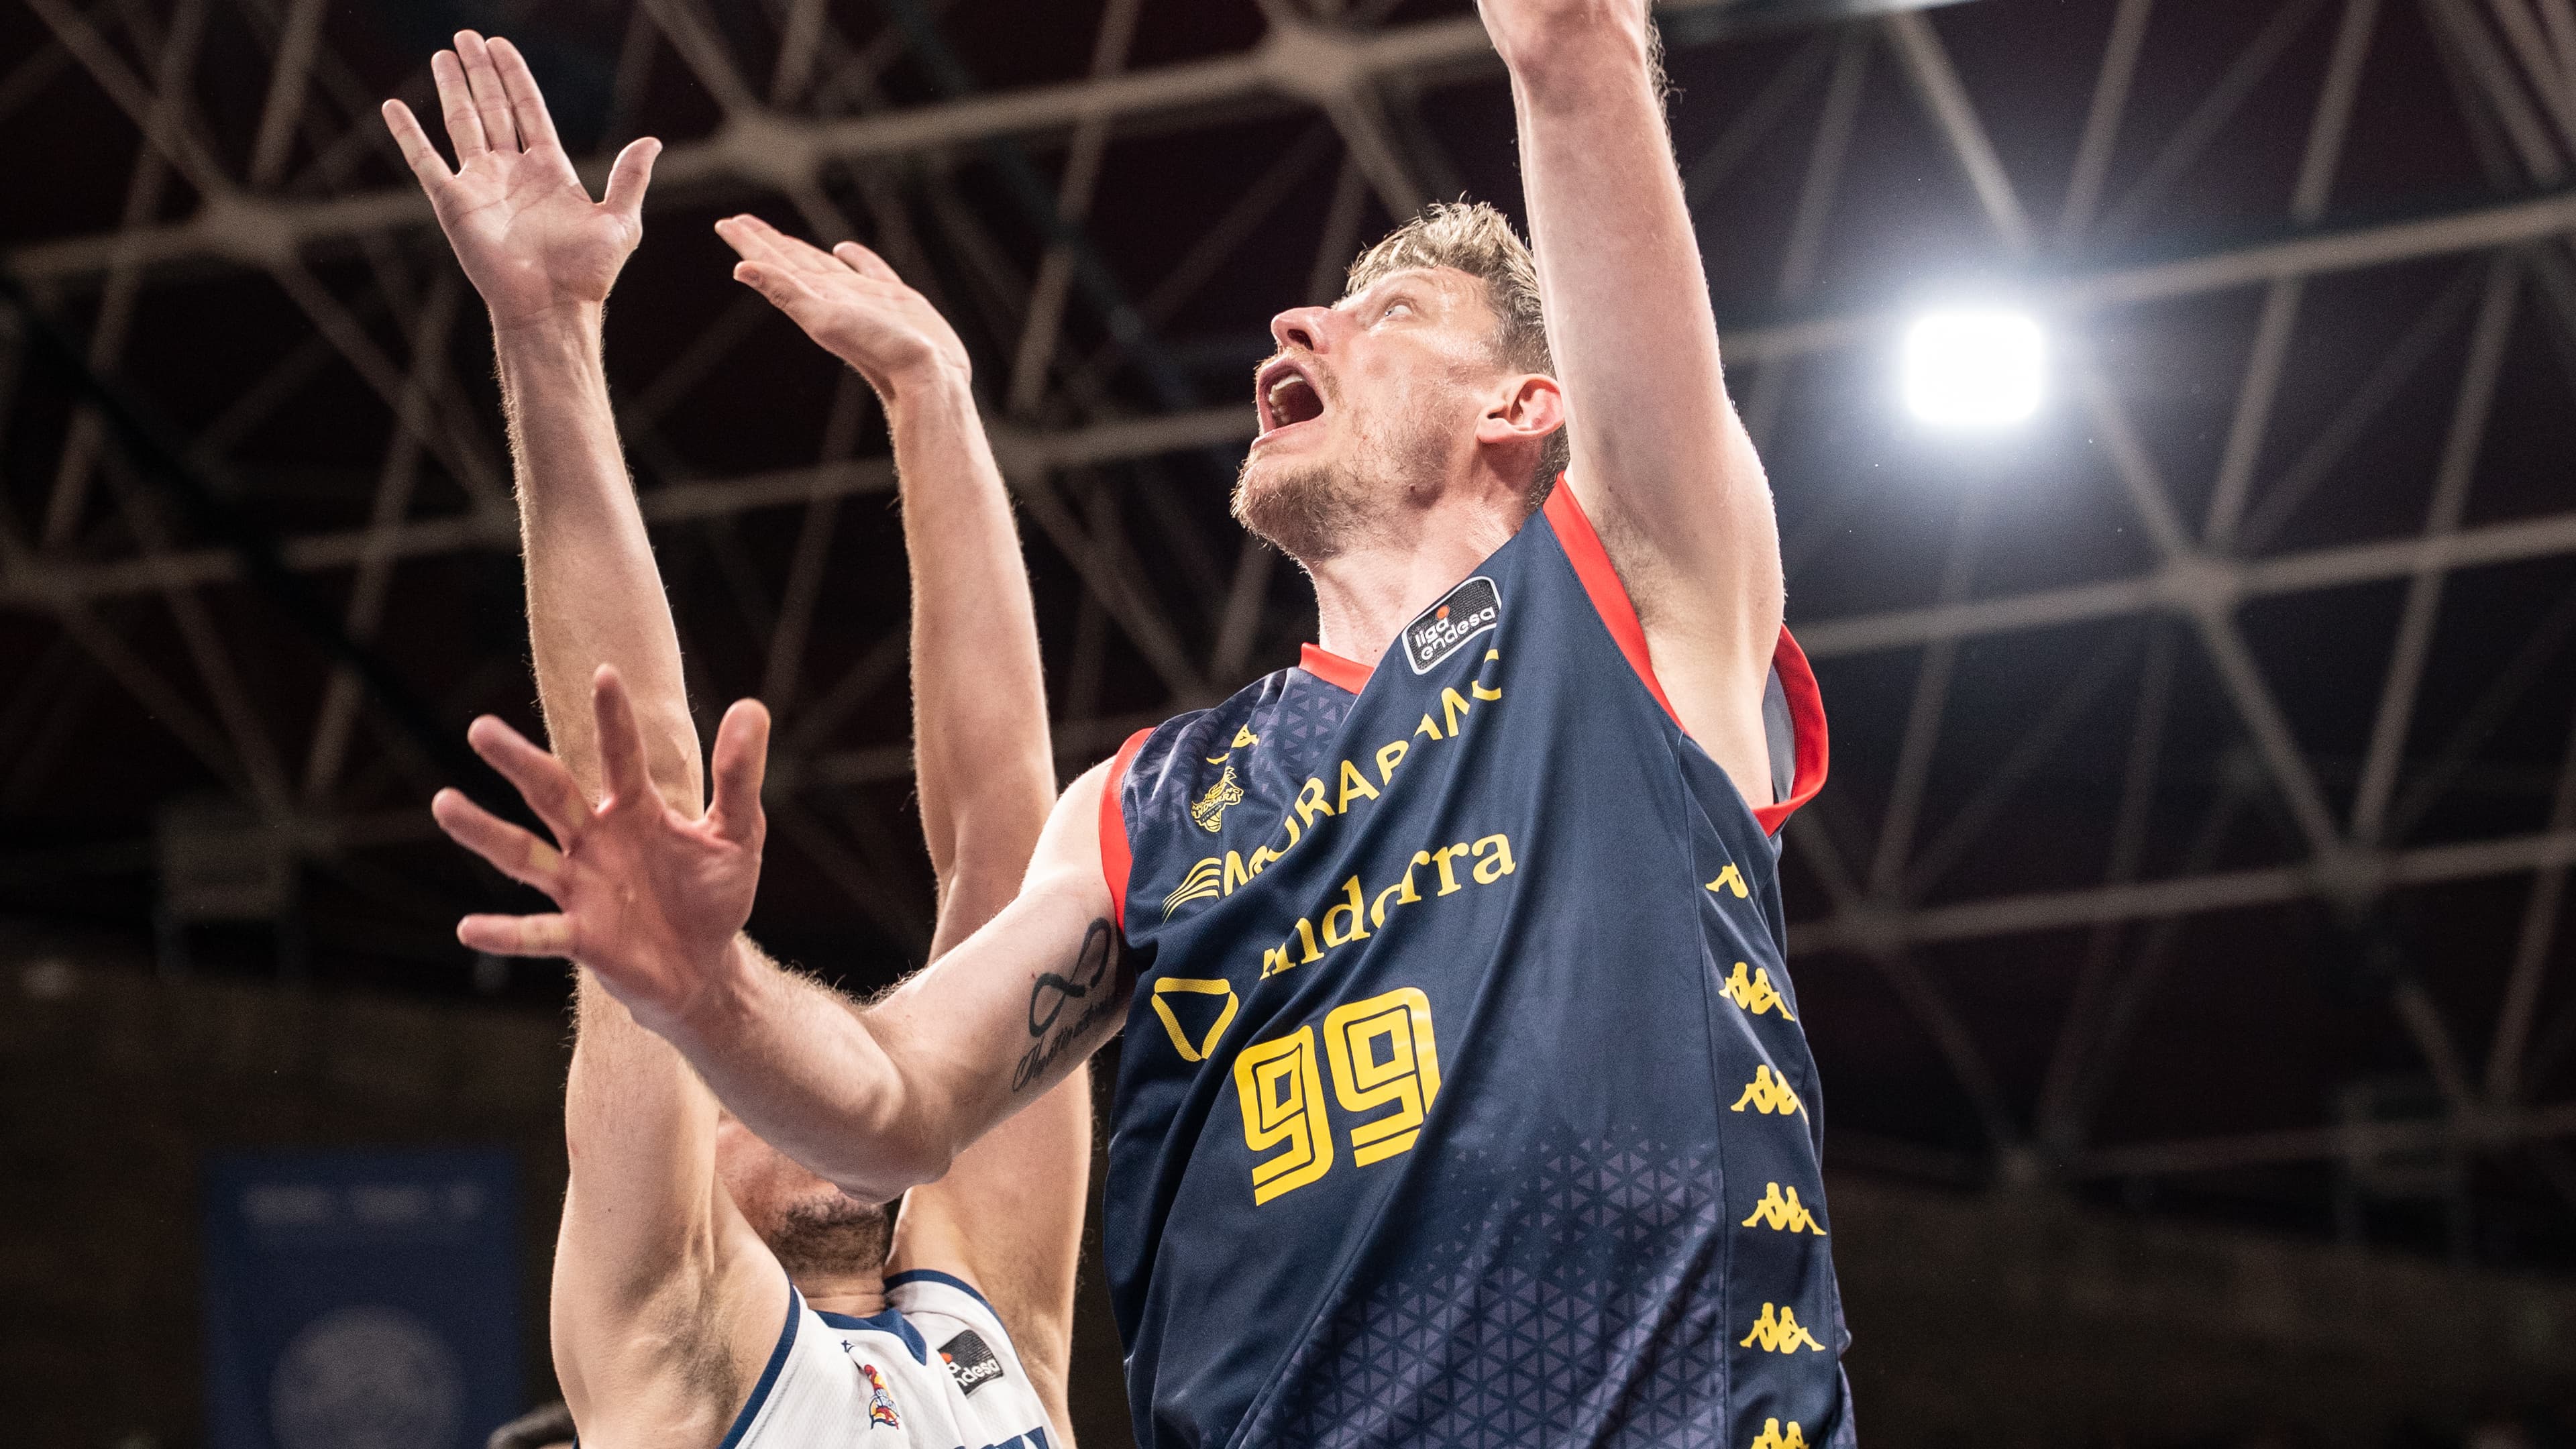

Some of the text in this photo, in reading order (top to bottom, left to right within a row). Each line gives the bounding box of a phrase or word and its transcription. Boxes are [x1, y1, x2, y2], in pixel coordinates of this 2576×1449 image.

[1415, 618, 1450, 648] liga
[1421, 606, 1495, 660] endesa
[1259, 833, 1517, 981] ndorra
[1234, 987, 1442, 1207] 99
[955, 1358, 1001, 1387] ndesa
